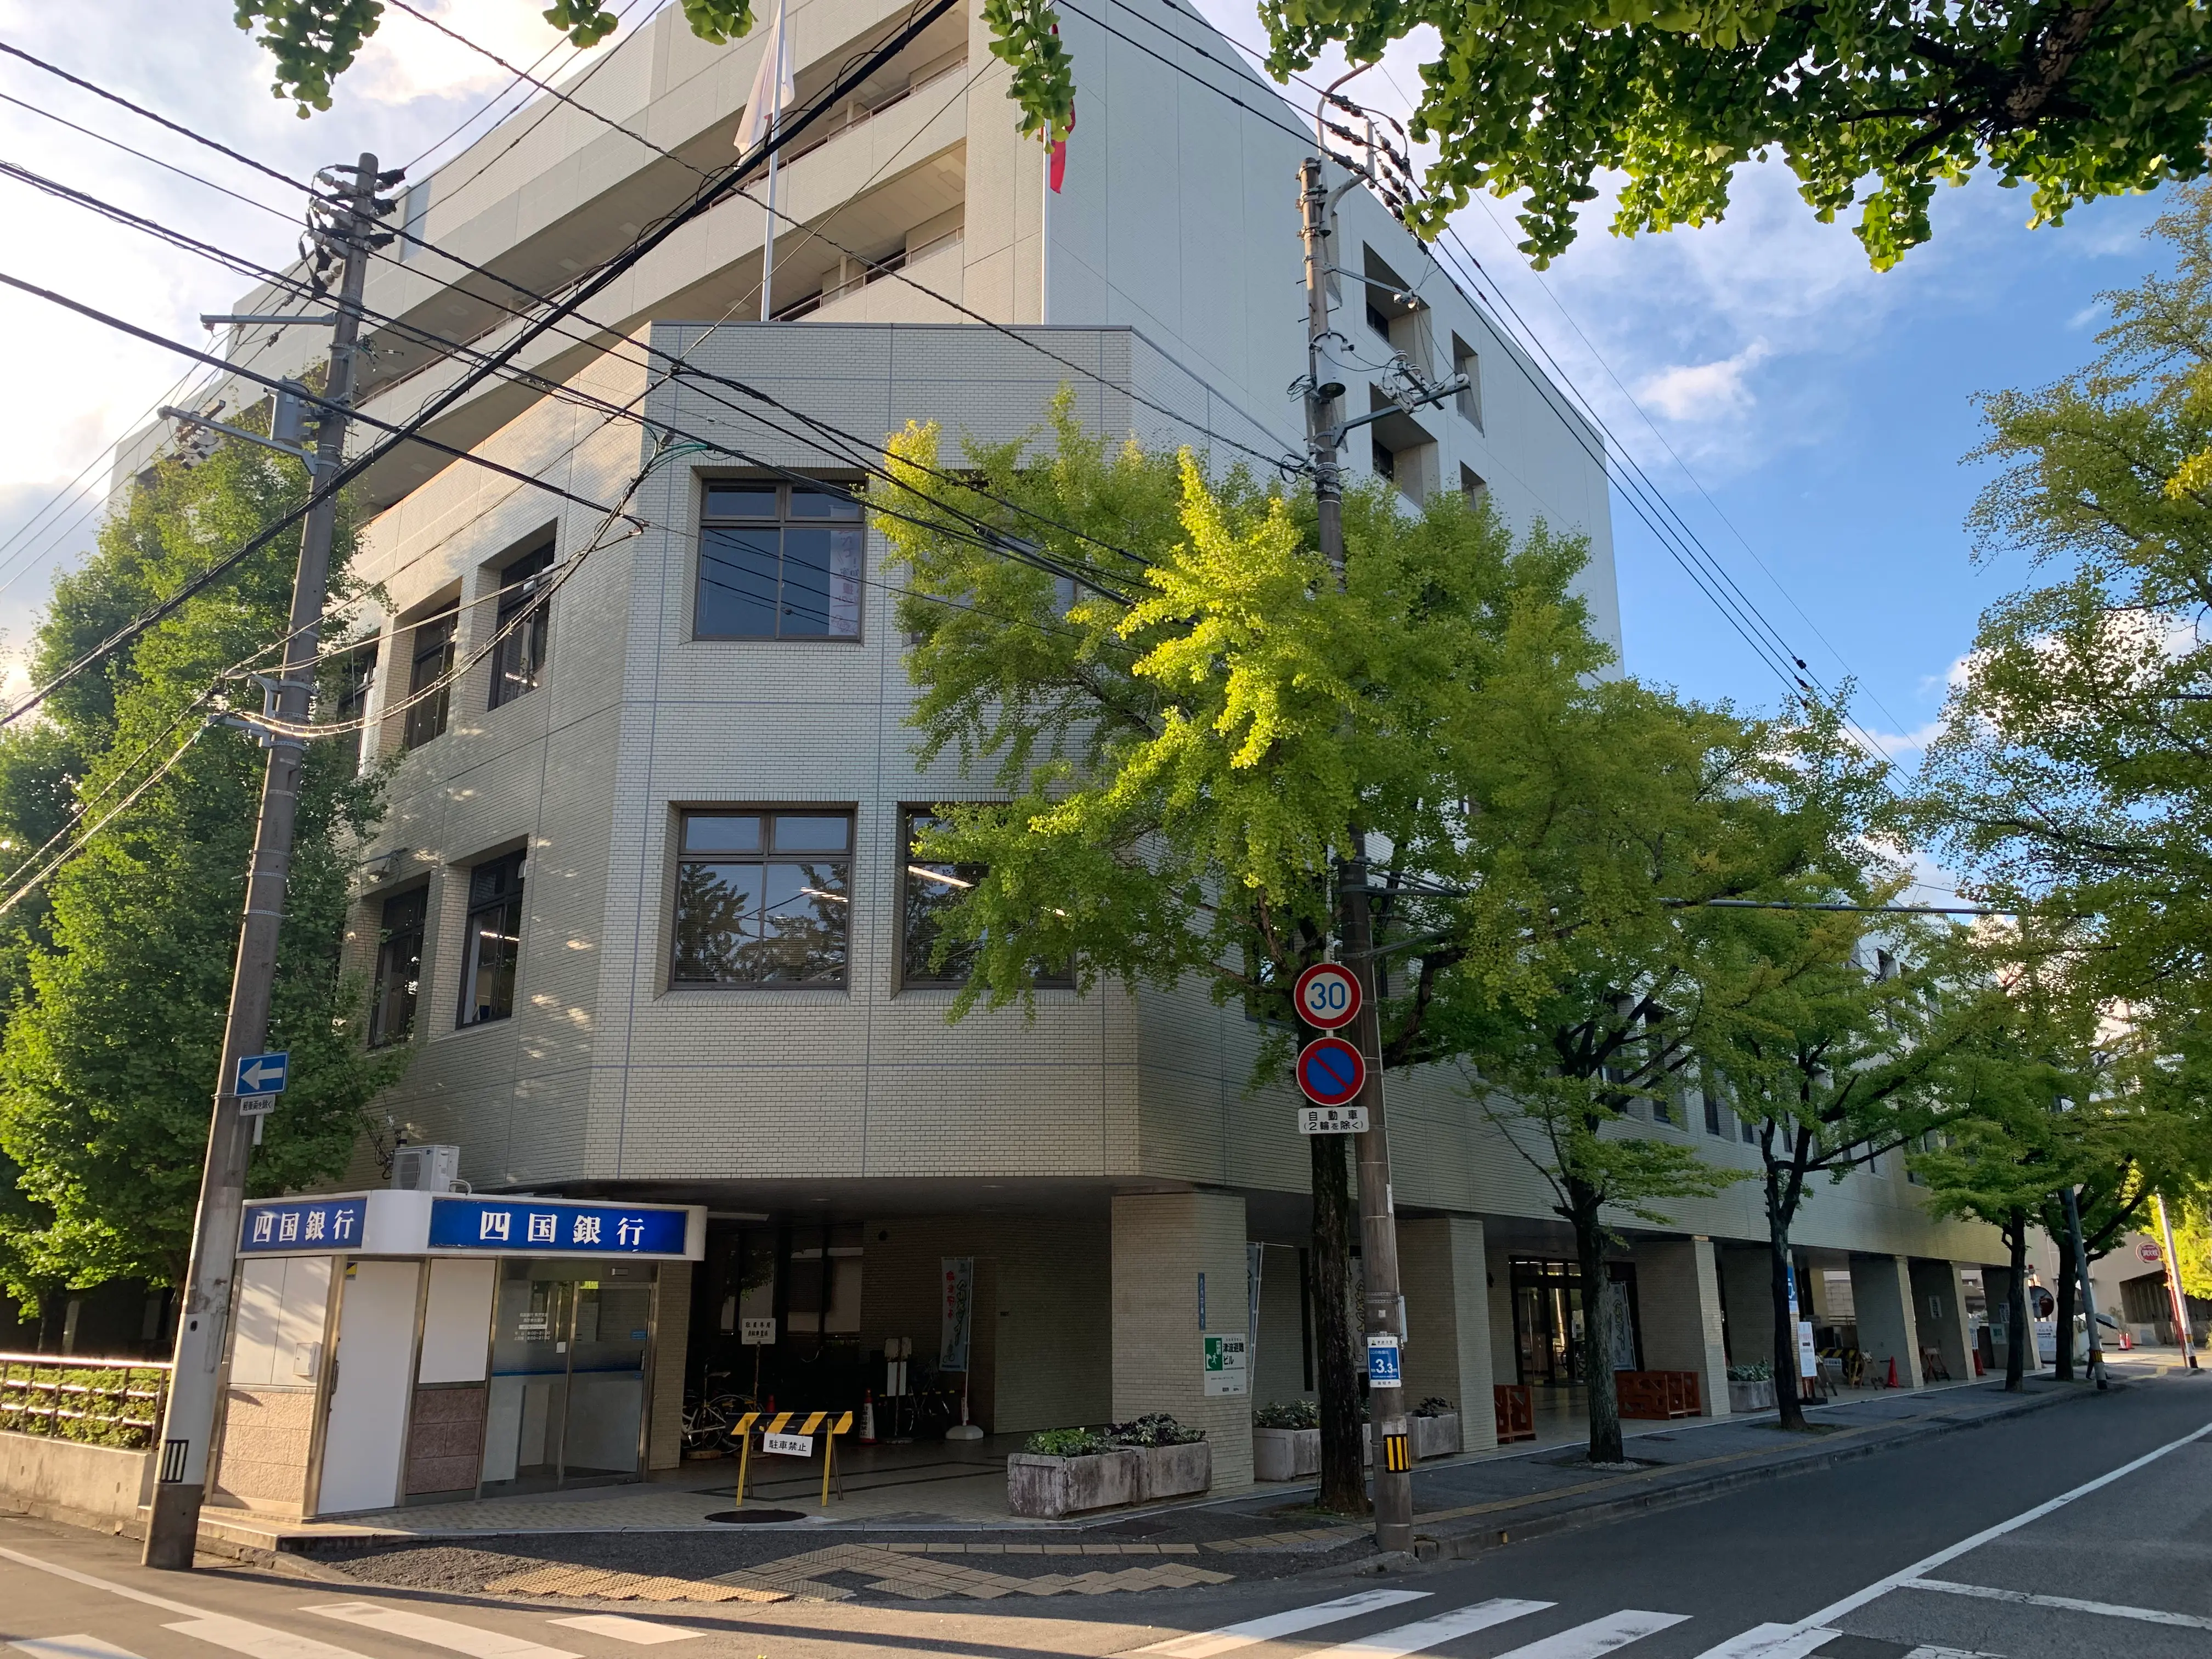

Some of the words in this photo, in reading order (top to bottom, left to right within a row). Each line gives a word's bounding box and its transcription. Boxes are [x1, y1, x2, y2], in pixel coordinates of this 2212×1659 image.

[1311, 982, 1346, 1010] 30
[243, 1099, 272, 1111] 軽車両を除く
[1308, 1110, 1358, 1121] 自動車
[252, 1209, 354, 1243] 四国銀行
[479, 1210, 645, 1246] 四国銀行
[1223, 1355, 1234, 1365] ビル
[769, 1440, 807, 1452] 駐車禁止
